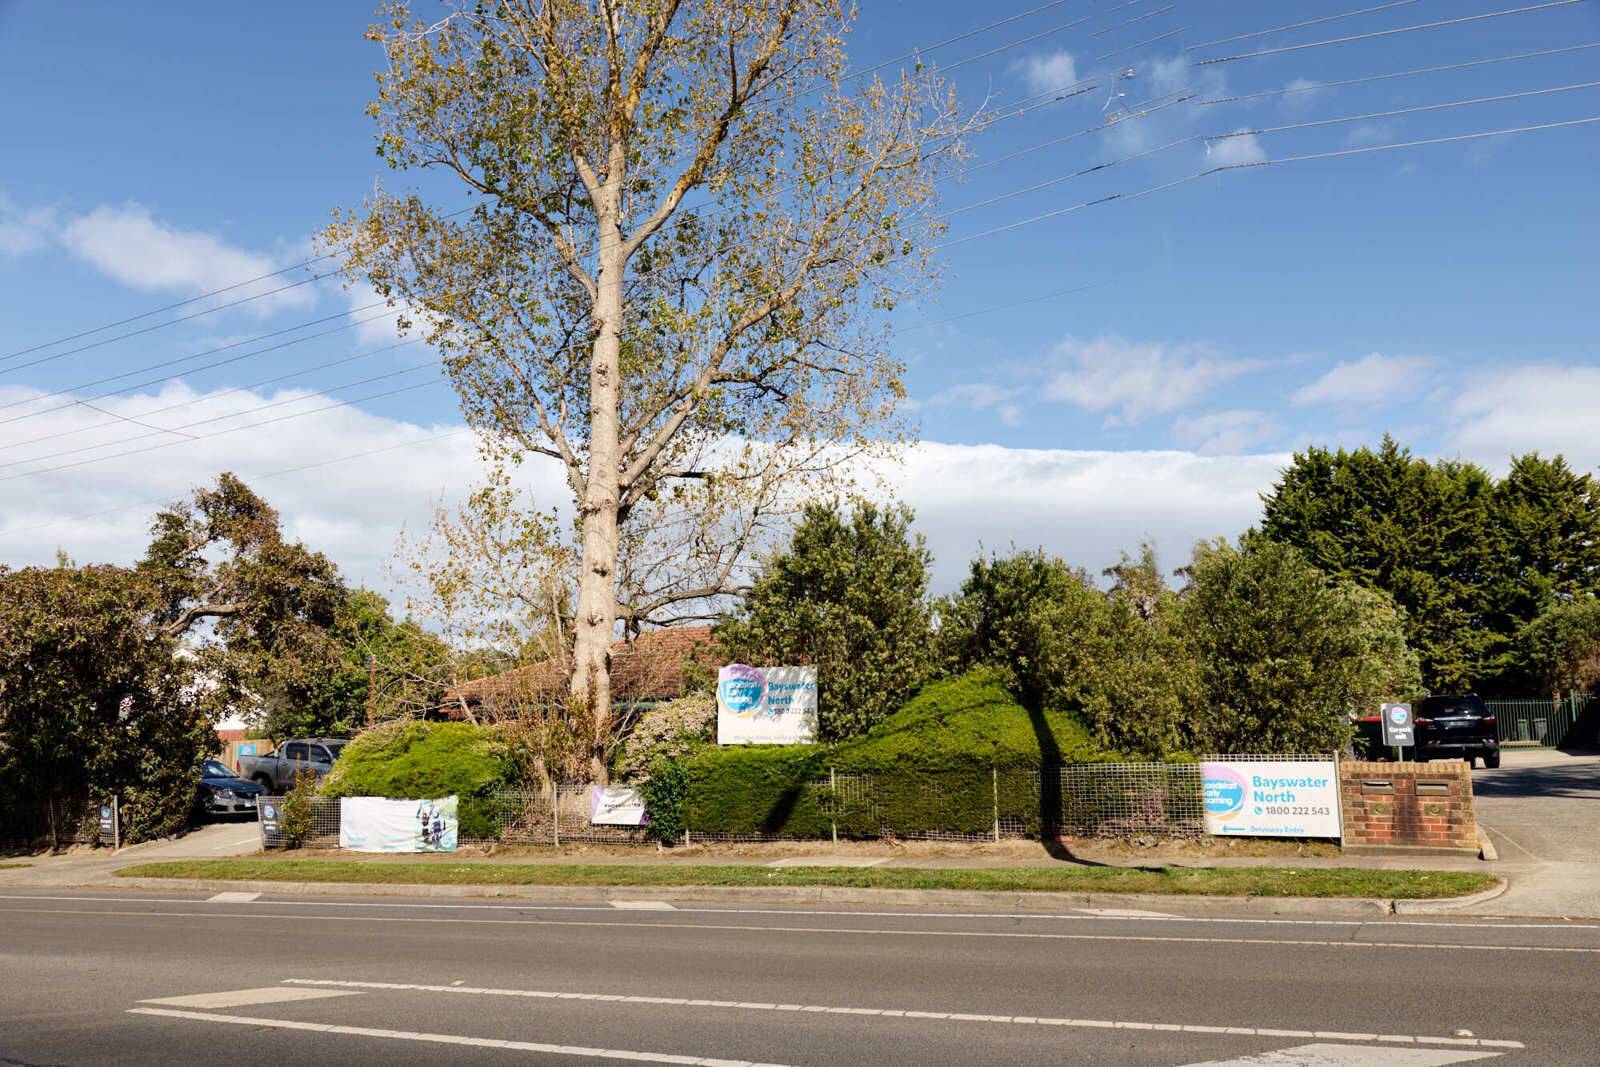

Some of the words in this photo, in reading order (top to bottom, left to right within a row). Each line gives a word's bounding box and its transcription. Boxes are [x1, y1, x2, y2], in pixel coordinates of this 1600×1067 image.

[768, 682, 815, 692] Bayswater
[767, 695, 794, 705] North
[1252, 776, 1328, 790] Bayswater
[1253, 790, 1296, 803] North
[1265, 806, 1290, 816] 1800
[1292, 806, 1309, 816] 222
[1311, 806, 1330, 816] 543
[1250, 826, 1283, 834] Driveway
[1284, 826, 1304, 834] Entry
